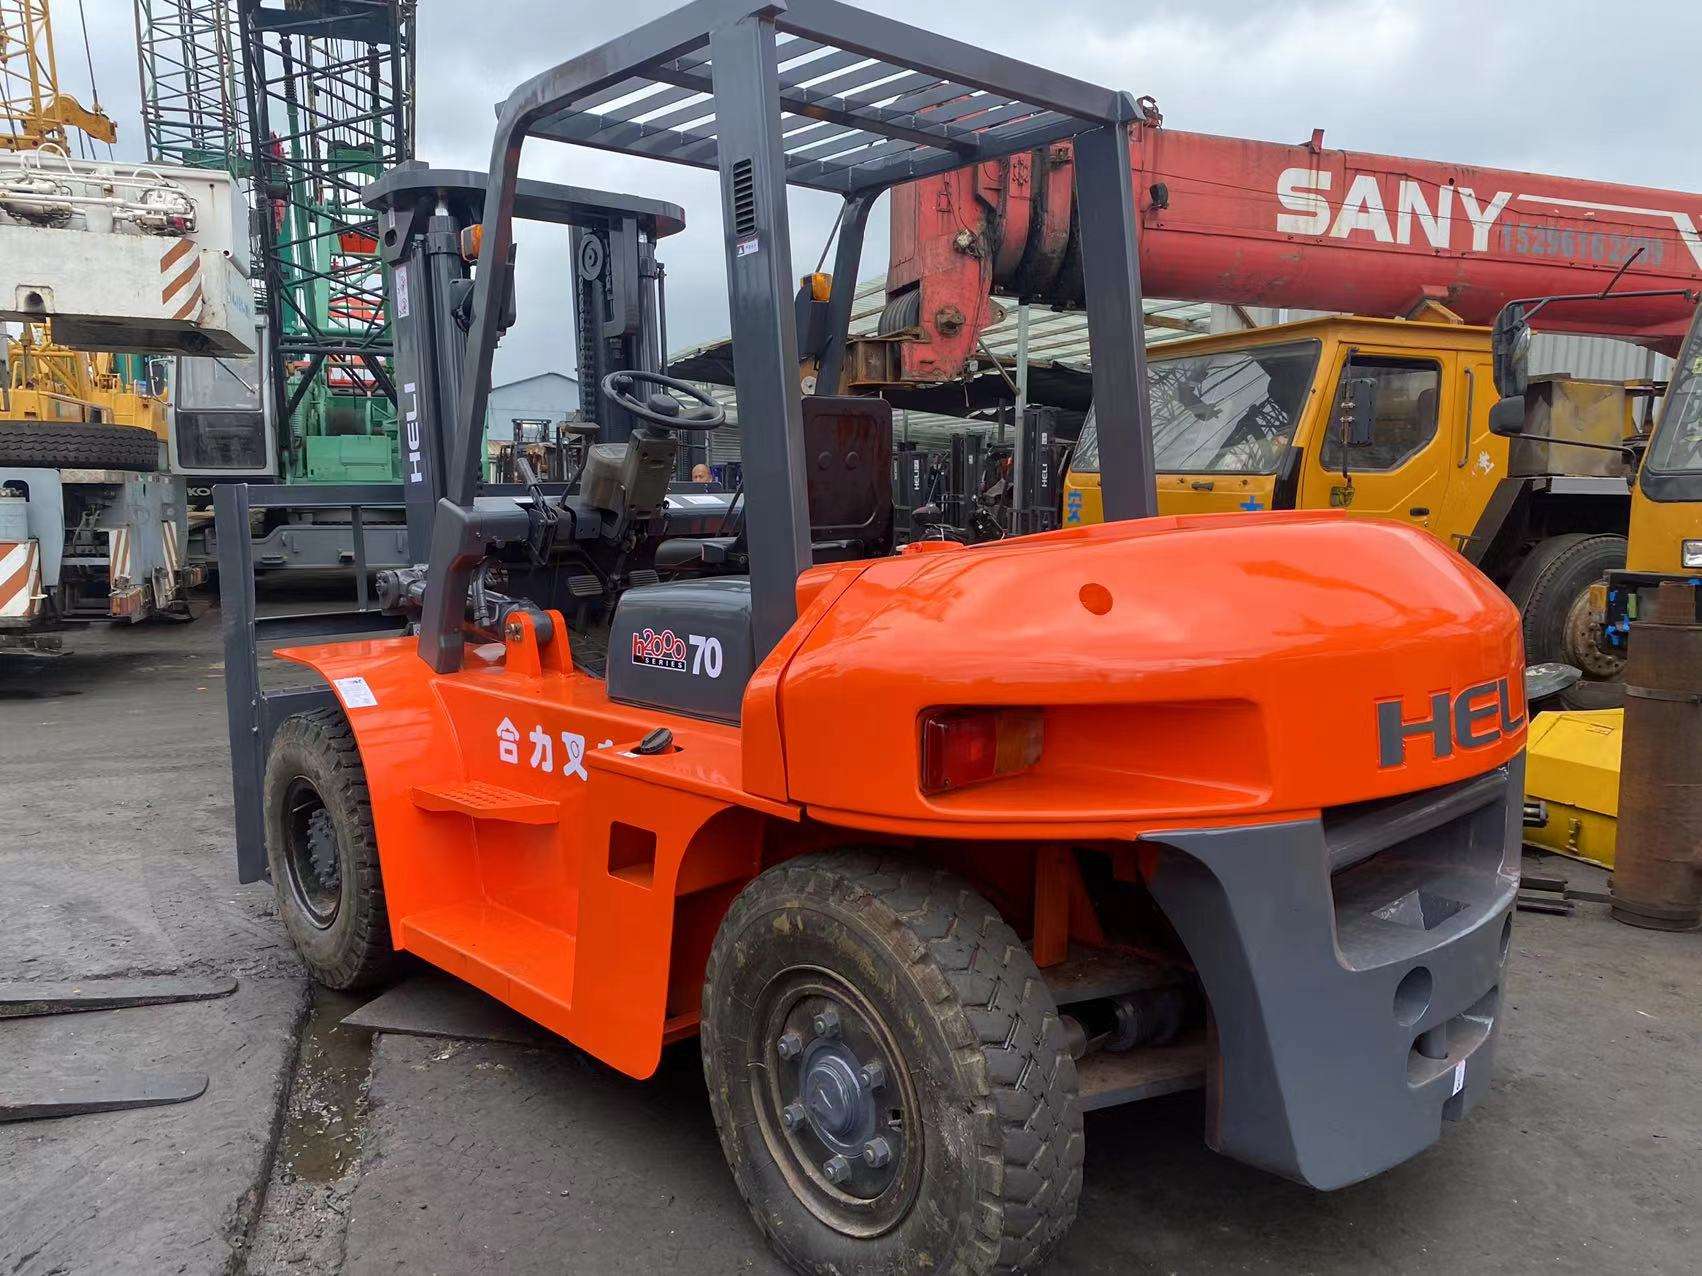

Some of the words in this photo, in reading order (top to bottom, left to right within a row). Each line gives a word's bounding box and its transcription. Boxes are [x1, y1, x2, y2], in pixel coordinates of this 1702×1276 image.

[1276, 167, 1513, 252] SANY
[403, 382, 423, 483] HELI
[632, 628, 687, 661] h2000
[689, 634, 723, 678] 70
[644, 657, 683, 669] SERIES
[496, 716, 614, 782] 合力叉
